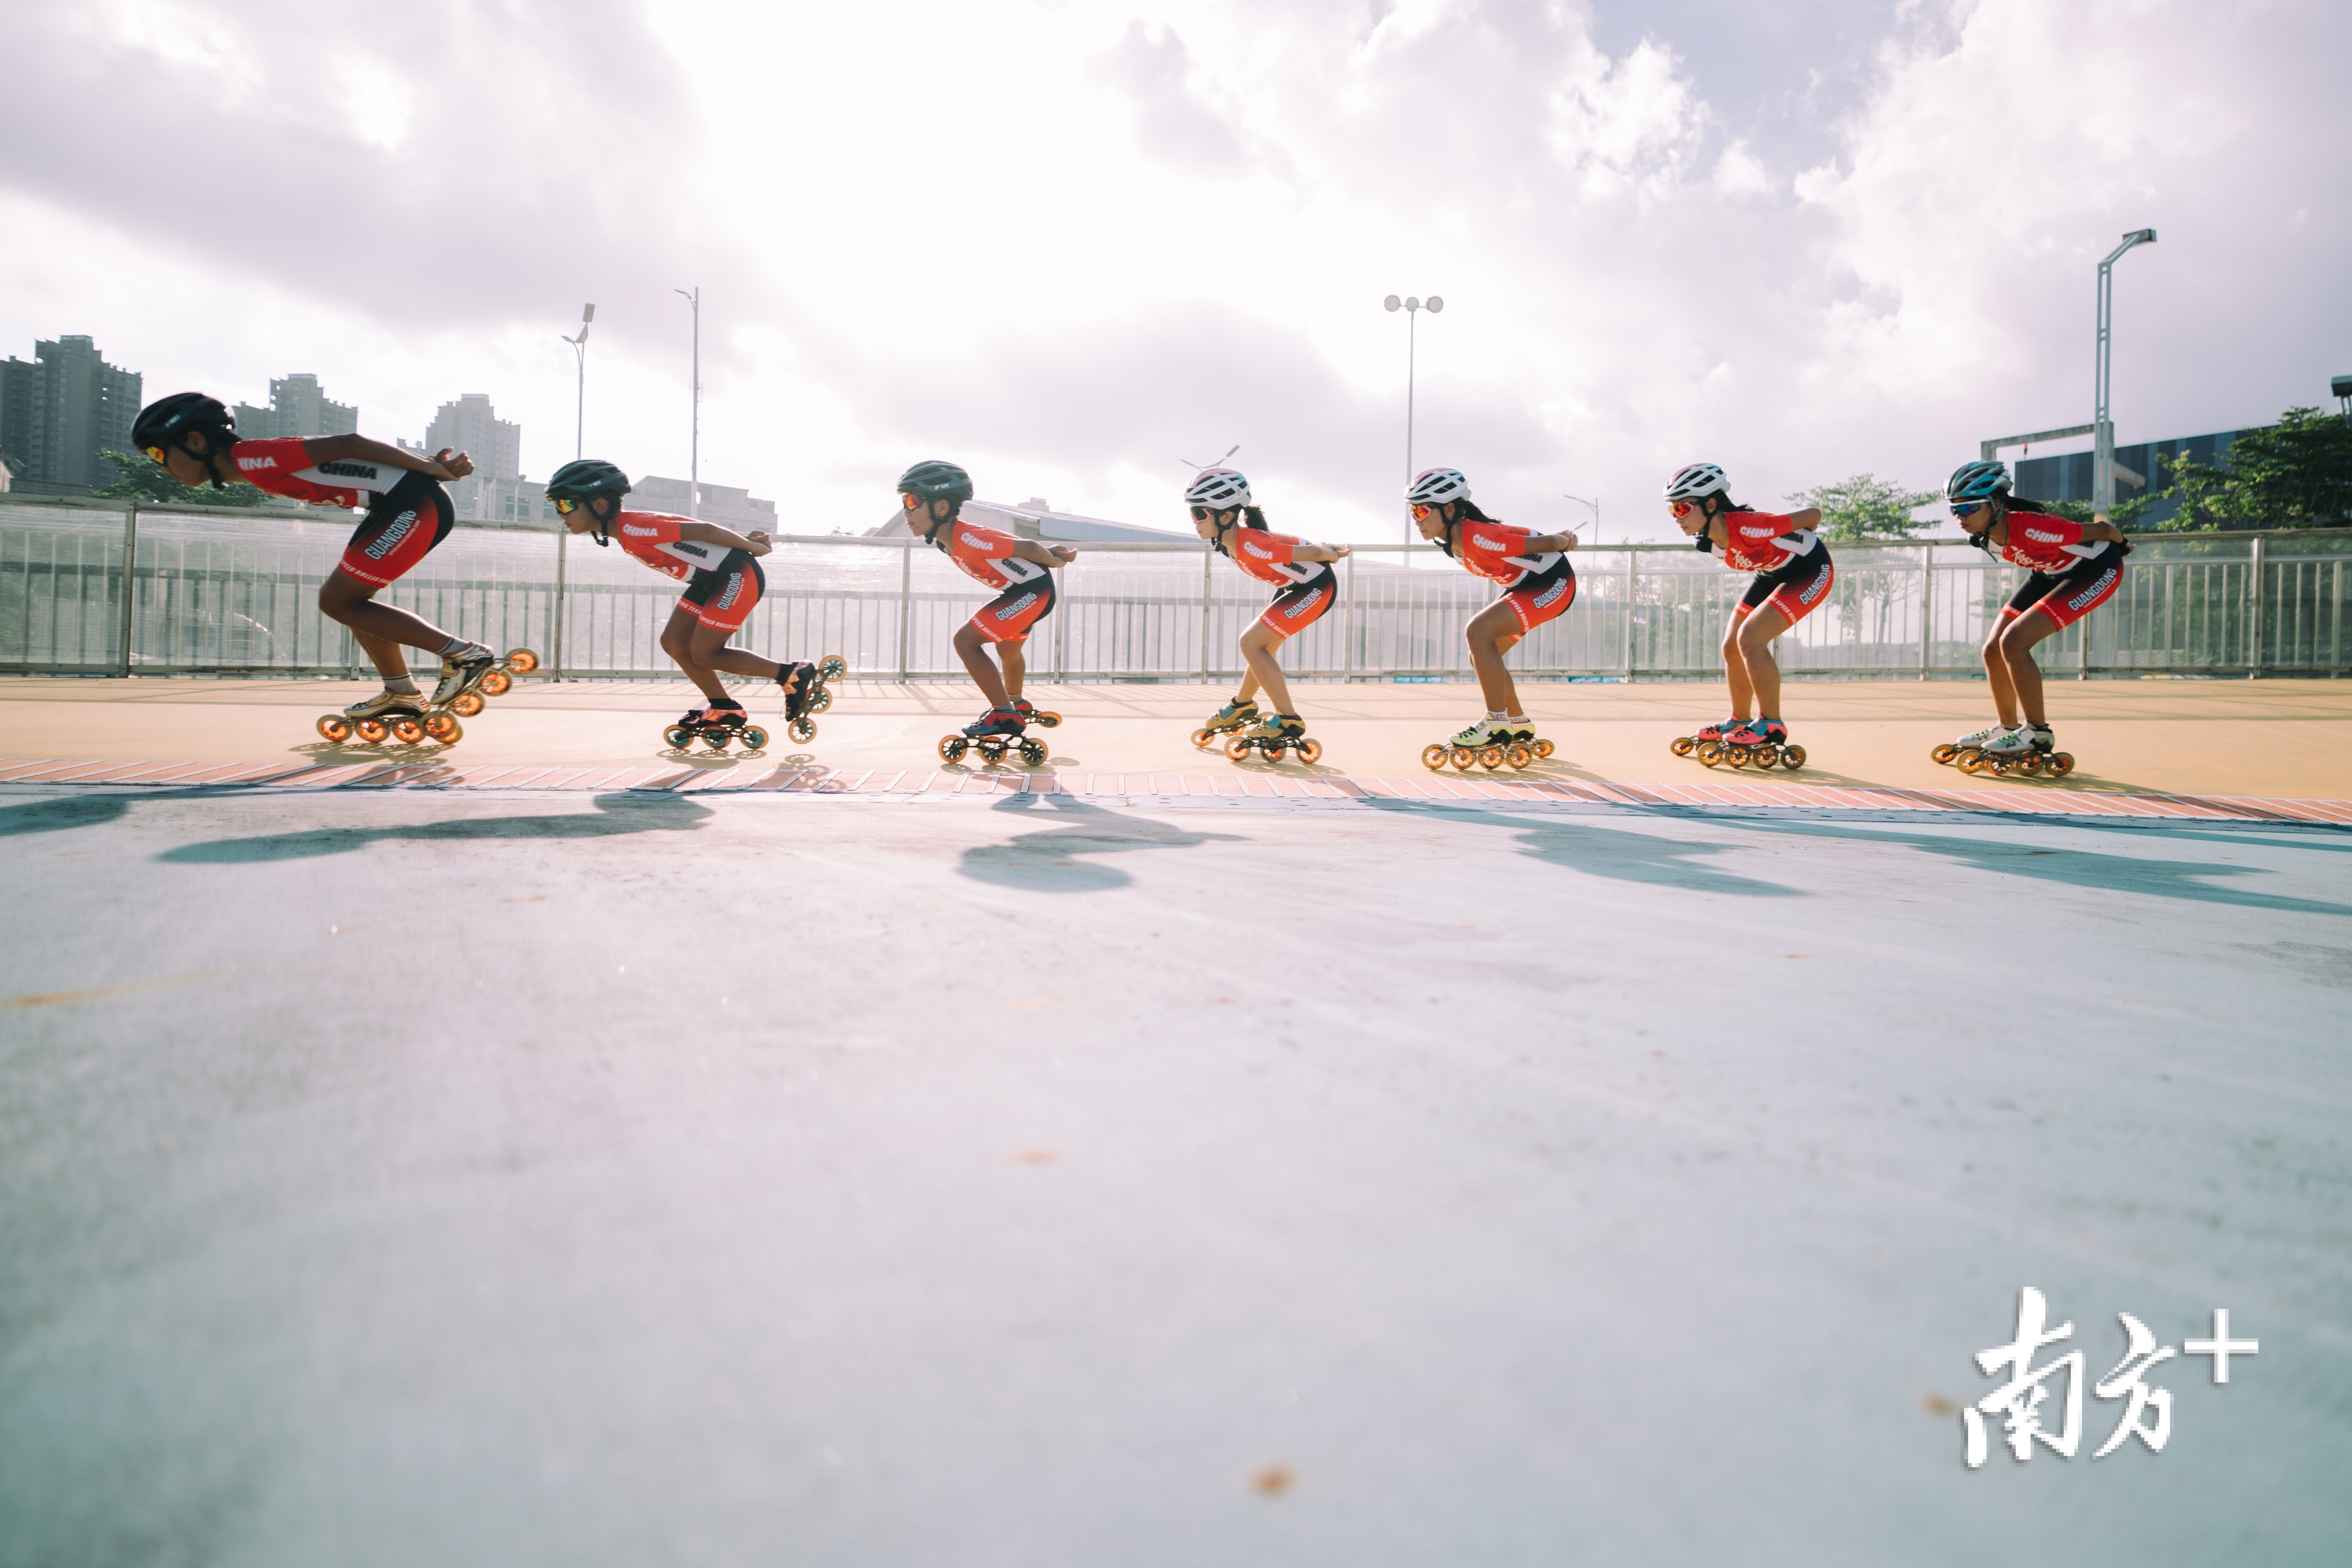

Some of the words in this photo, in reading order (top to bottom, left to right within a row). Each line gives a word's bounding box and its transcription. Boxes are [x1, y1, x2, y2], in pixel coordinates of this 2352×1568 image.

[237, 456, 278, 471] HINA
[318, 461, 378, 480] CHINA
[364, 510, 417, 560] GUANGDONG
[622, 523, 659, 537] CHINA
[1739, 526, 1774, 538] CHINA
[2024, 528, 2064, 543] CHINA
[673, 542, 708, 558] CHINA
[961, 532, 994, 551] CHINA
[1243, 541, 1273, 560] CHINA
[1473, 534, 1506, 552] CHINA
[1001, 559, 1029, 577] CHINA
[717, 573, 742, 610] GUANGDONG
[1533, 578, 1567, 608] GUANGDONG
[1799, 564, 1830, 605] GUANGDONG
[2068, 568, 2117, 611] GUANGDONG
[995, 592, 1037, 621] GUANGDONG
[1284, 588, 1322, 619] GUANGDONG
